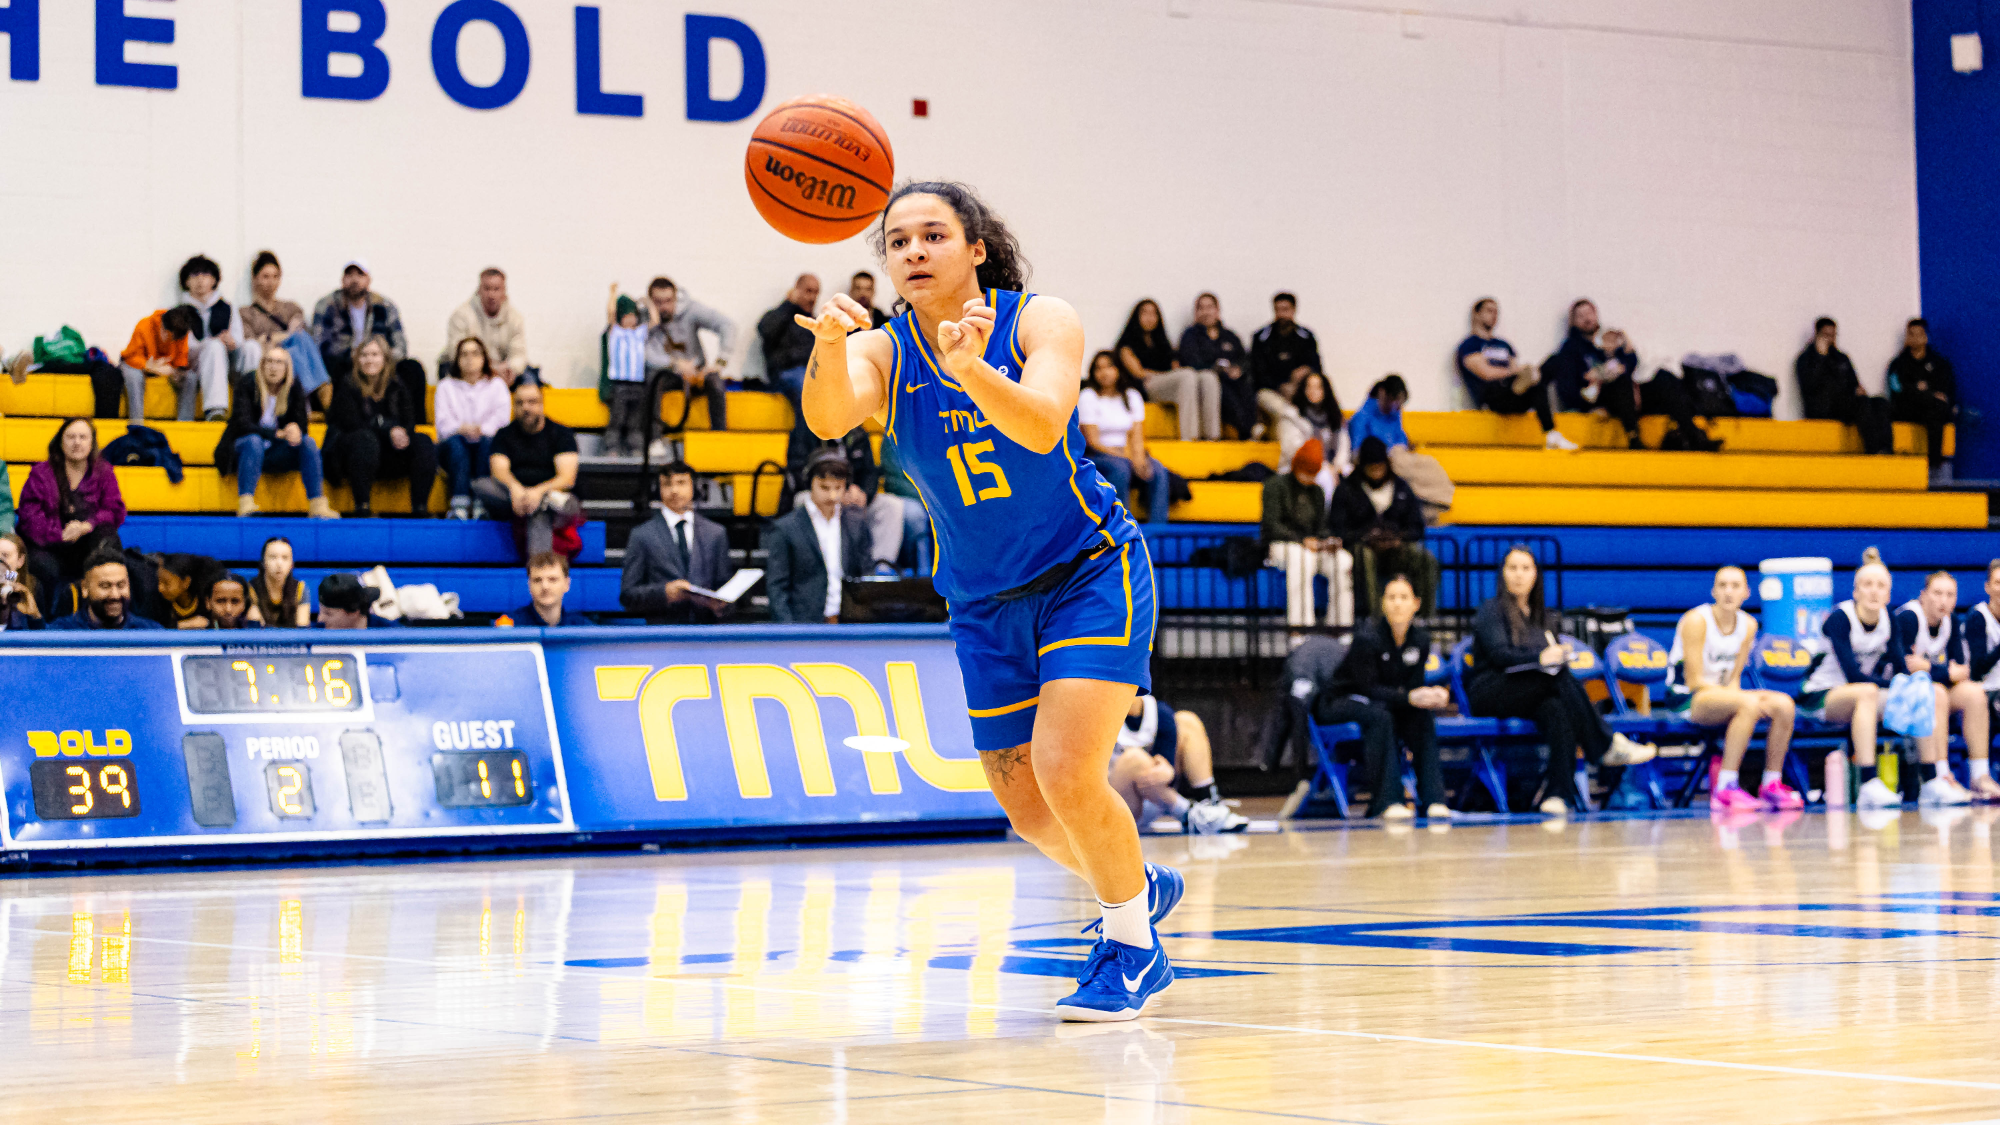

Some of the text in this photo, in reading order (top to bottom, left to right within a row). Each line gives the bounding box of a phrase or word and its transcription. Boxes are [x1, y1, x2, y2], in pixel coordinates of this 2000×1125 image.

[301, 0, 767, 123] BOLD
[765, 154, 857, 210] Wilson
[946, 439, 1012, 507] 15
[231, 659, 352, 708] 7:16
[27, 729, 132, 757] BOLD
[246, 735, 320, 761] PERIOD
[432, 719, 517, 750] GUEST
[66, 764, 131, 815] 39
[276, 766, 302, 815] 2
[477, 758, 525, 798] 11
